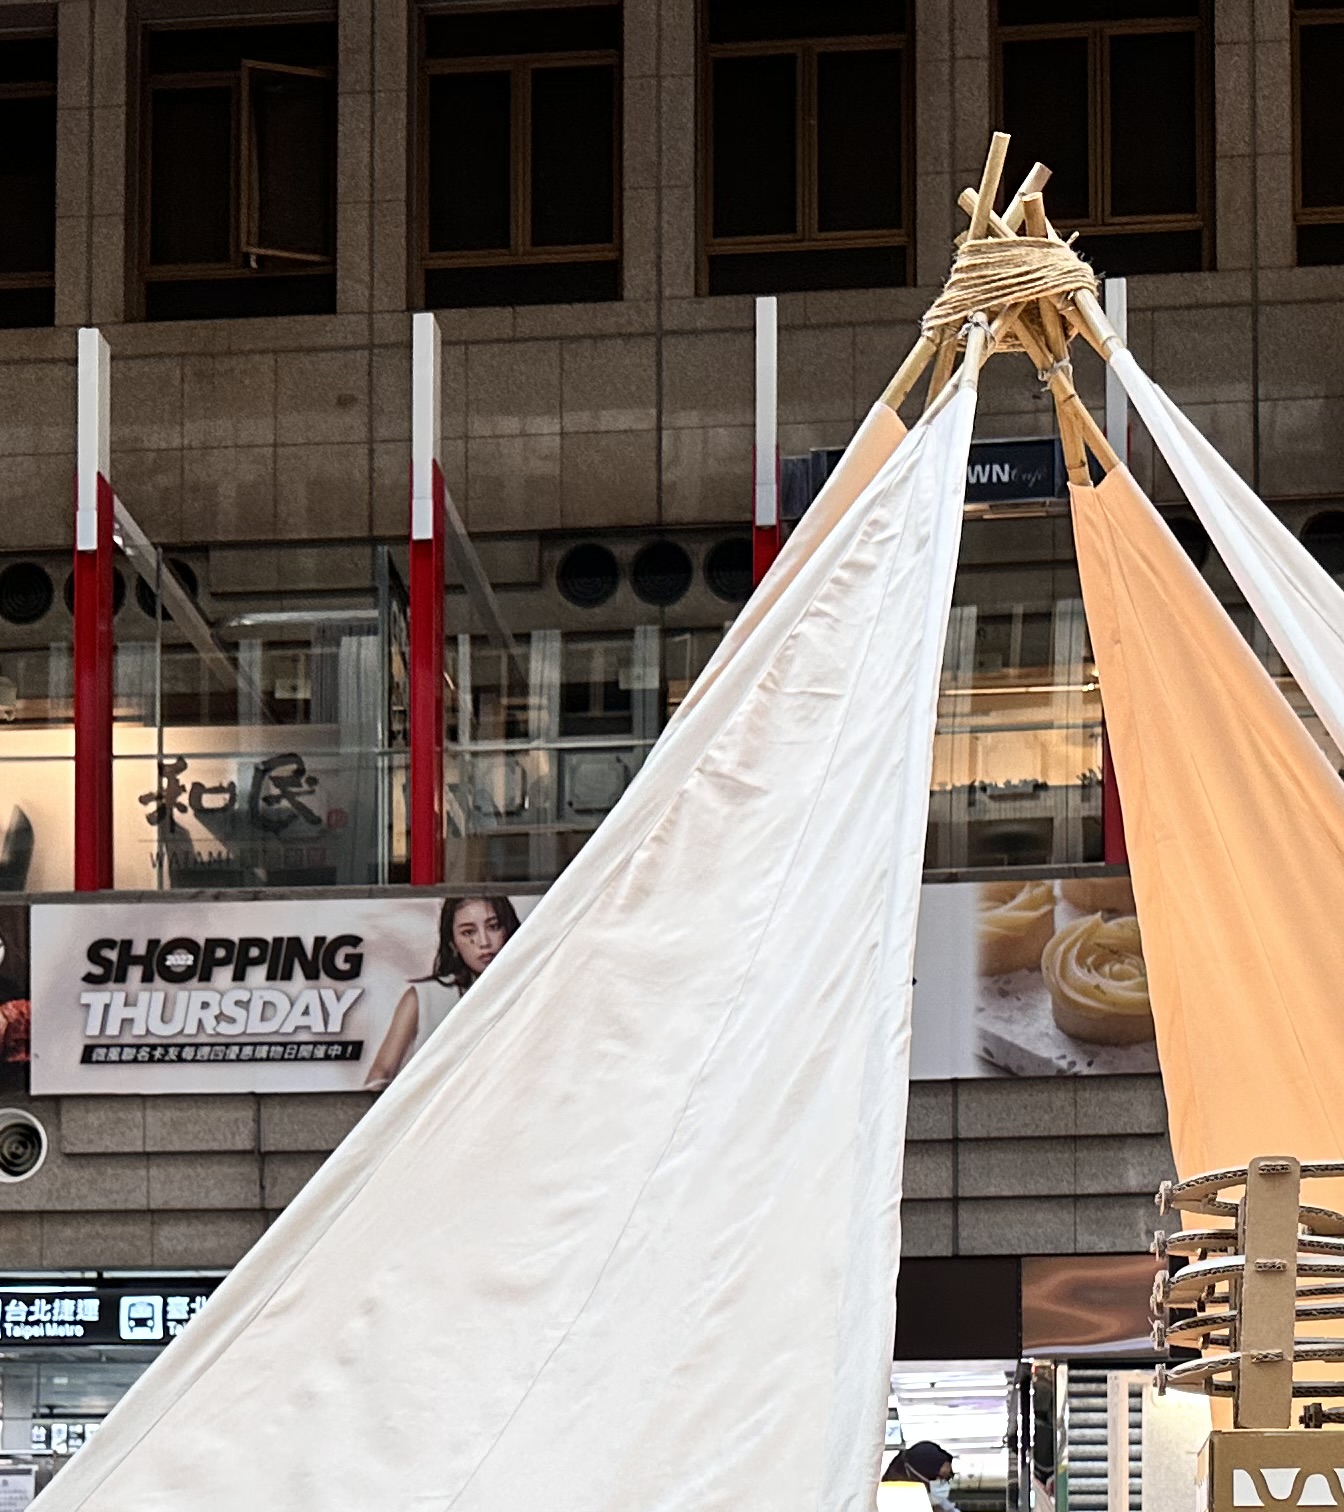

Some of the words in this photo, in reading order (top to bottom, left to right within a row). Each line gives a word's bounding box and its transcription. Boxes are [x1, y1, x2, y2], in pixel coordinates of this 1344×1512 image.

[968, 463, 1010, 484] WN
[138, 752, 321, 834] 和民
[82, 934, 364, 983] SHOPPING
[80, 987, 364, 1035] THURSDAY
[5, 1298, 100, 1322] 台北捷運
[4, 1322, 44, 1340] Taipei
[45, 1322, 84, 1337] Metro
